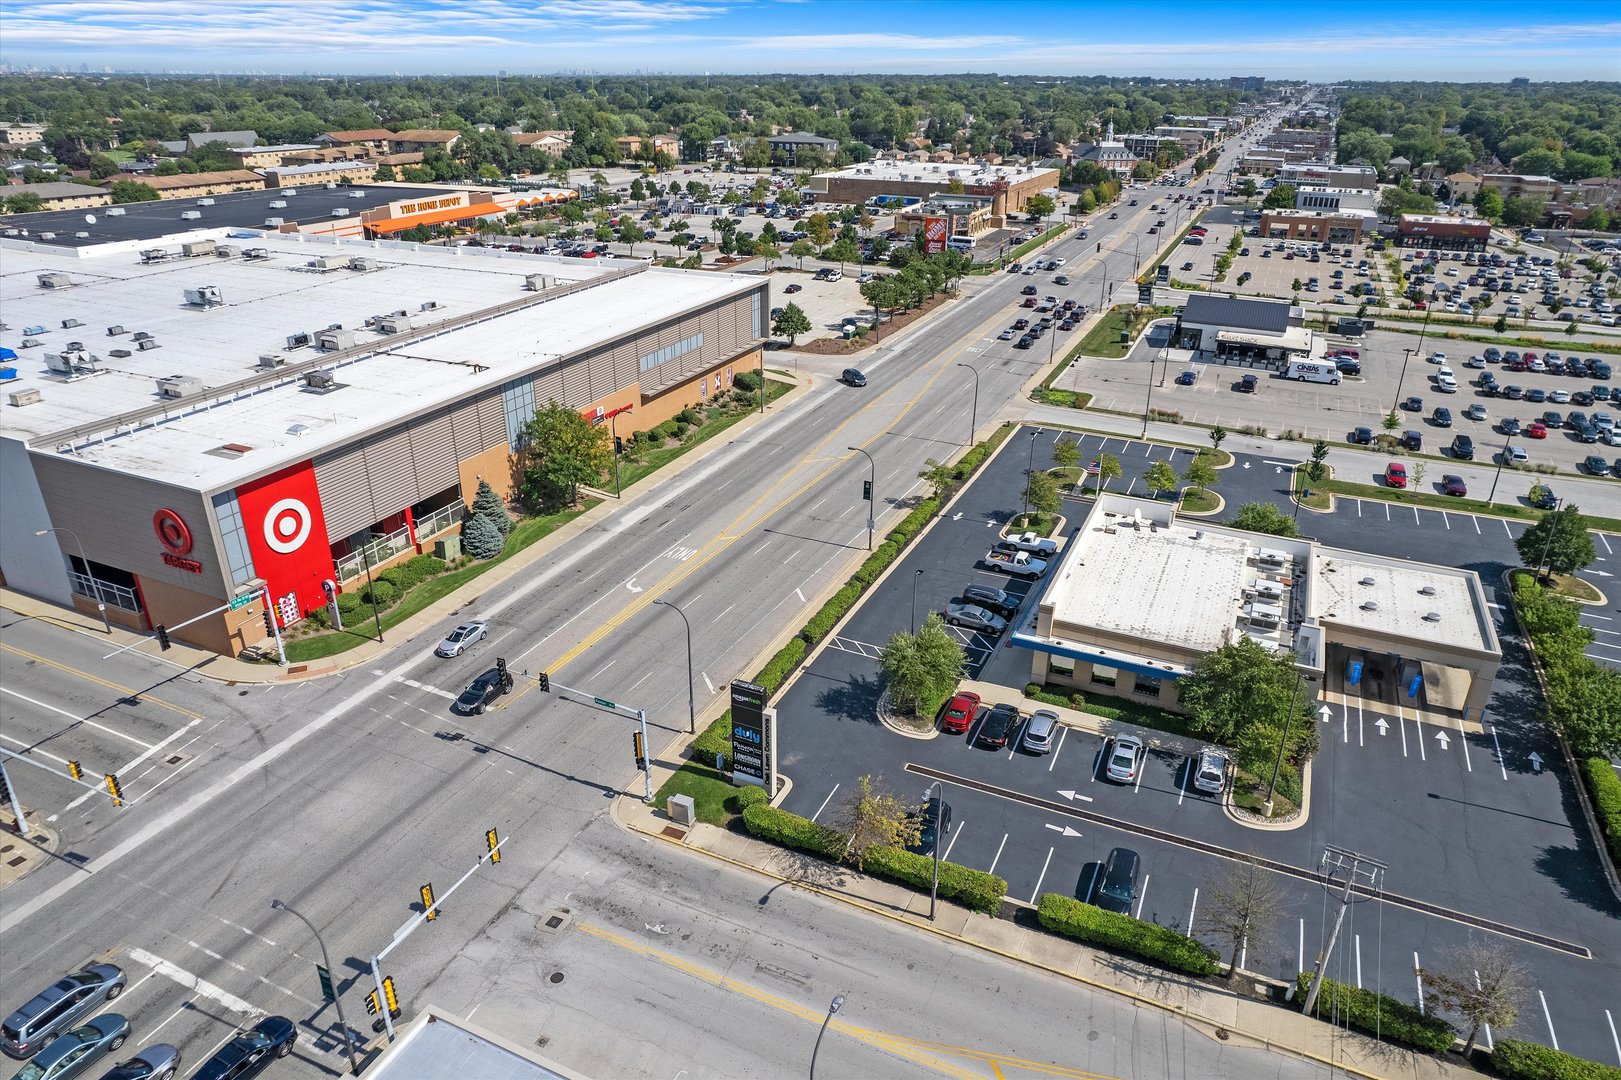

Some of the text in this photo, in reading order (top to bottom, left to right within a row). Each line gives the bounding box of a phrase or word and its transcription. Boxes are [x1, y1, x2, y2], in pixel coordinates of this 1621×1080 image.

[400, 197, 461, 214] THE HOME DEPOT
[926, 219, 946, 240] HOME
[1297, 363, 1320, 373] CINTAS
[663, 546, 698, 561] ONLY
[161, 552, 202, 574] TARGET
[734, 727, 761, 743] duly
[733, 764, 756, 775] CHASE
